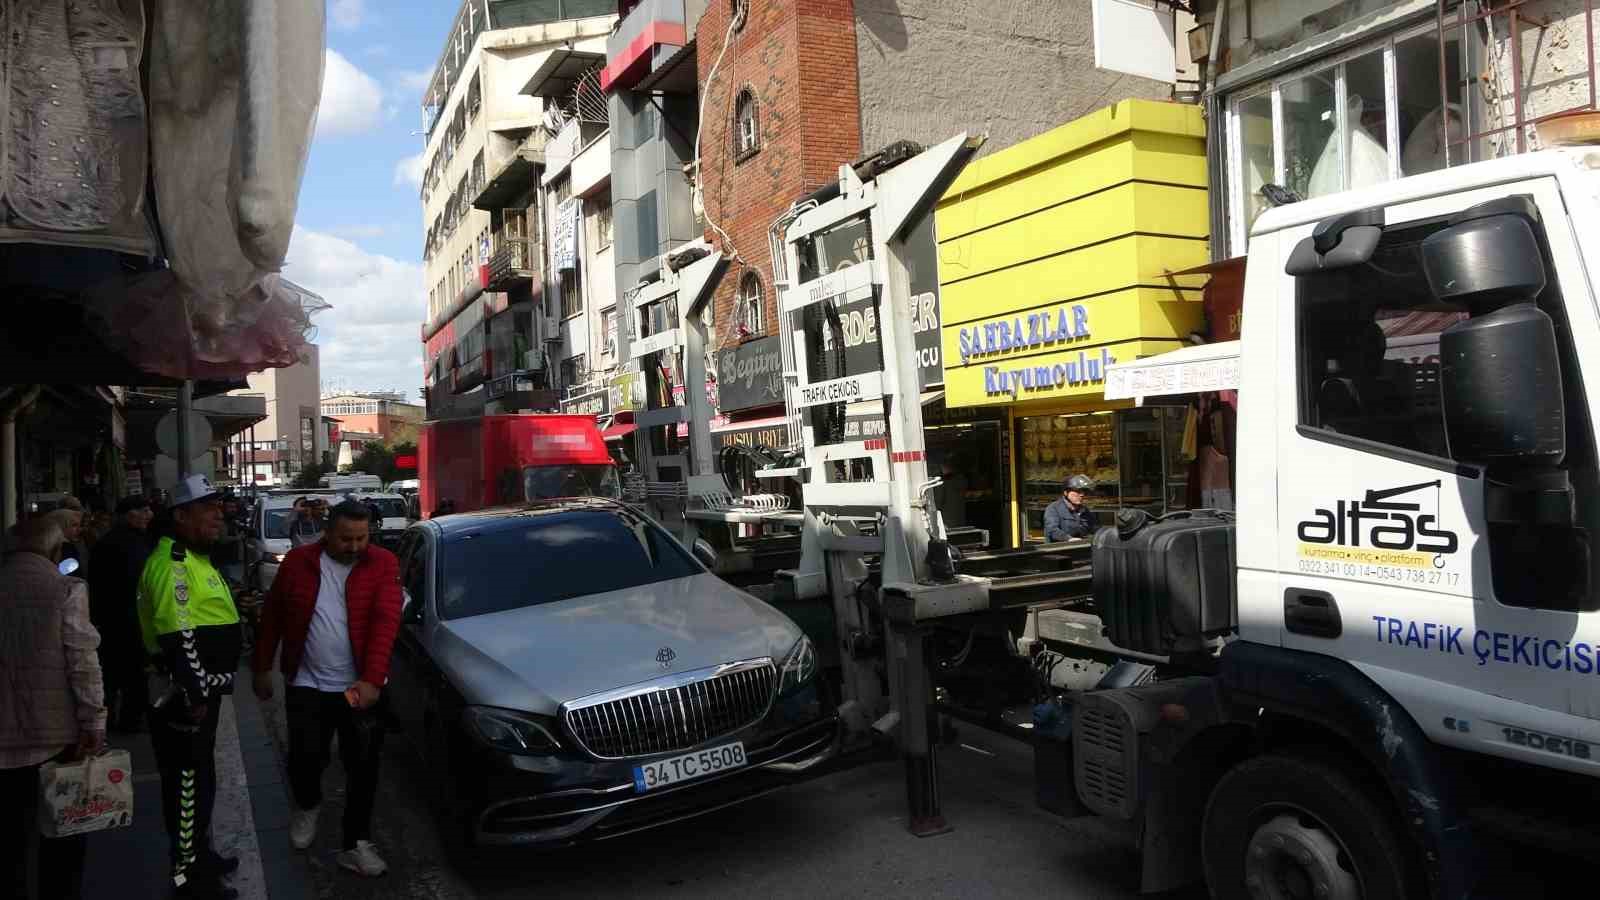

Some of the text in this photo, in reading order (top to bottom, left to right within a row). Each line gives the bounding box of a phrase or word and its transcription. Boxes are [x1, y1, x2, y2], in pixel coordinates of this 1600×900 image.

[960, 305, 1090, 367] ŞAHBAZLAR
[1298, 560, 1321, 573] 0322
[1324, 562, 1340, 574] 341
[1343, 564, 1357, 577] 00
[1406, 569, 1425, 583] 738
[1428, 571, 1441, 585] 27
[1446, 573, 1460, 587] 17
[1304, 547, 1425, 566] kurtarma vinç platform
[644, 763, 669, 786] 34
[670, 757, 697, 779] TC
[699, 745, 744, 772] 5508
